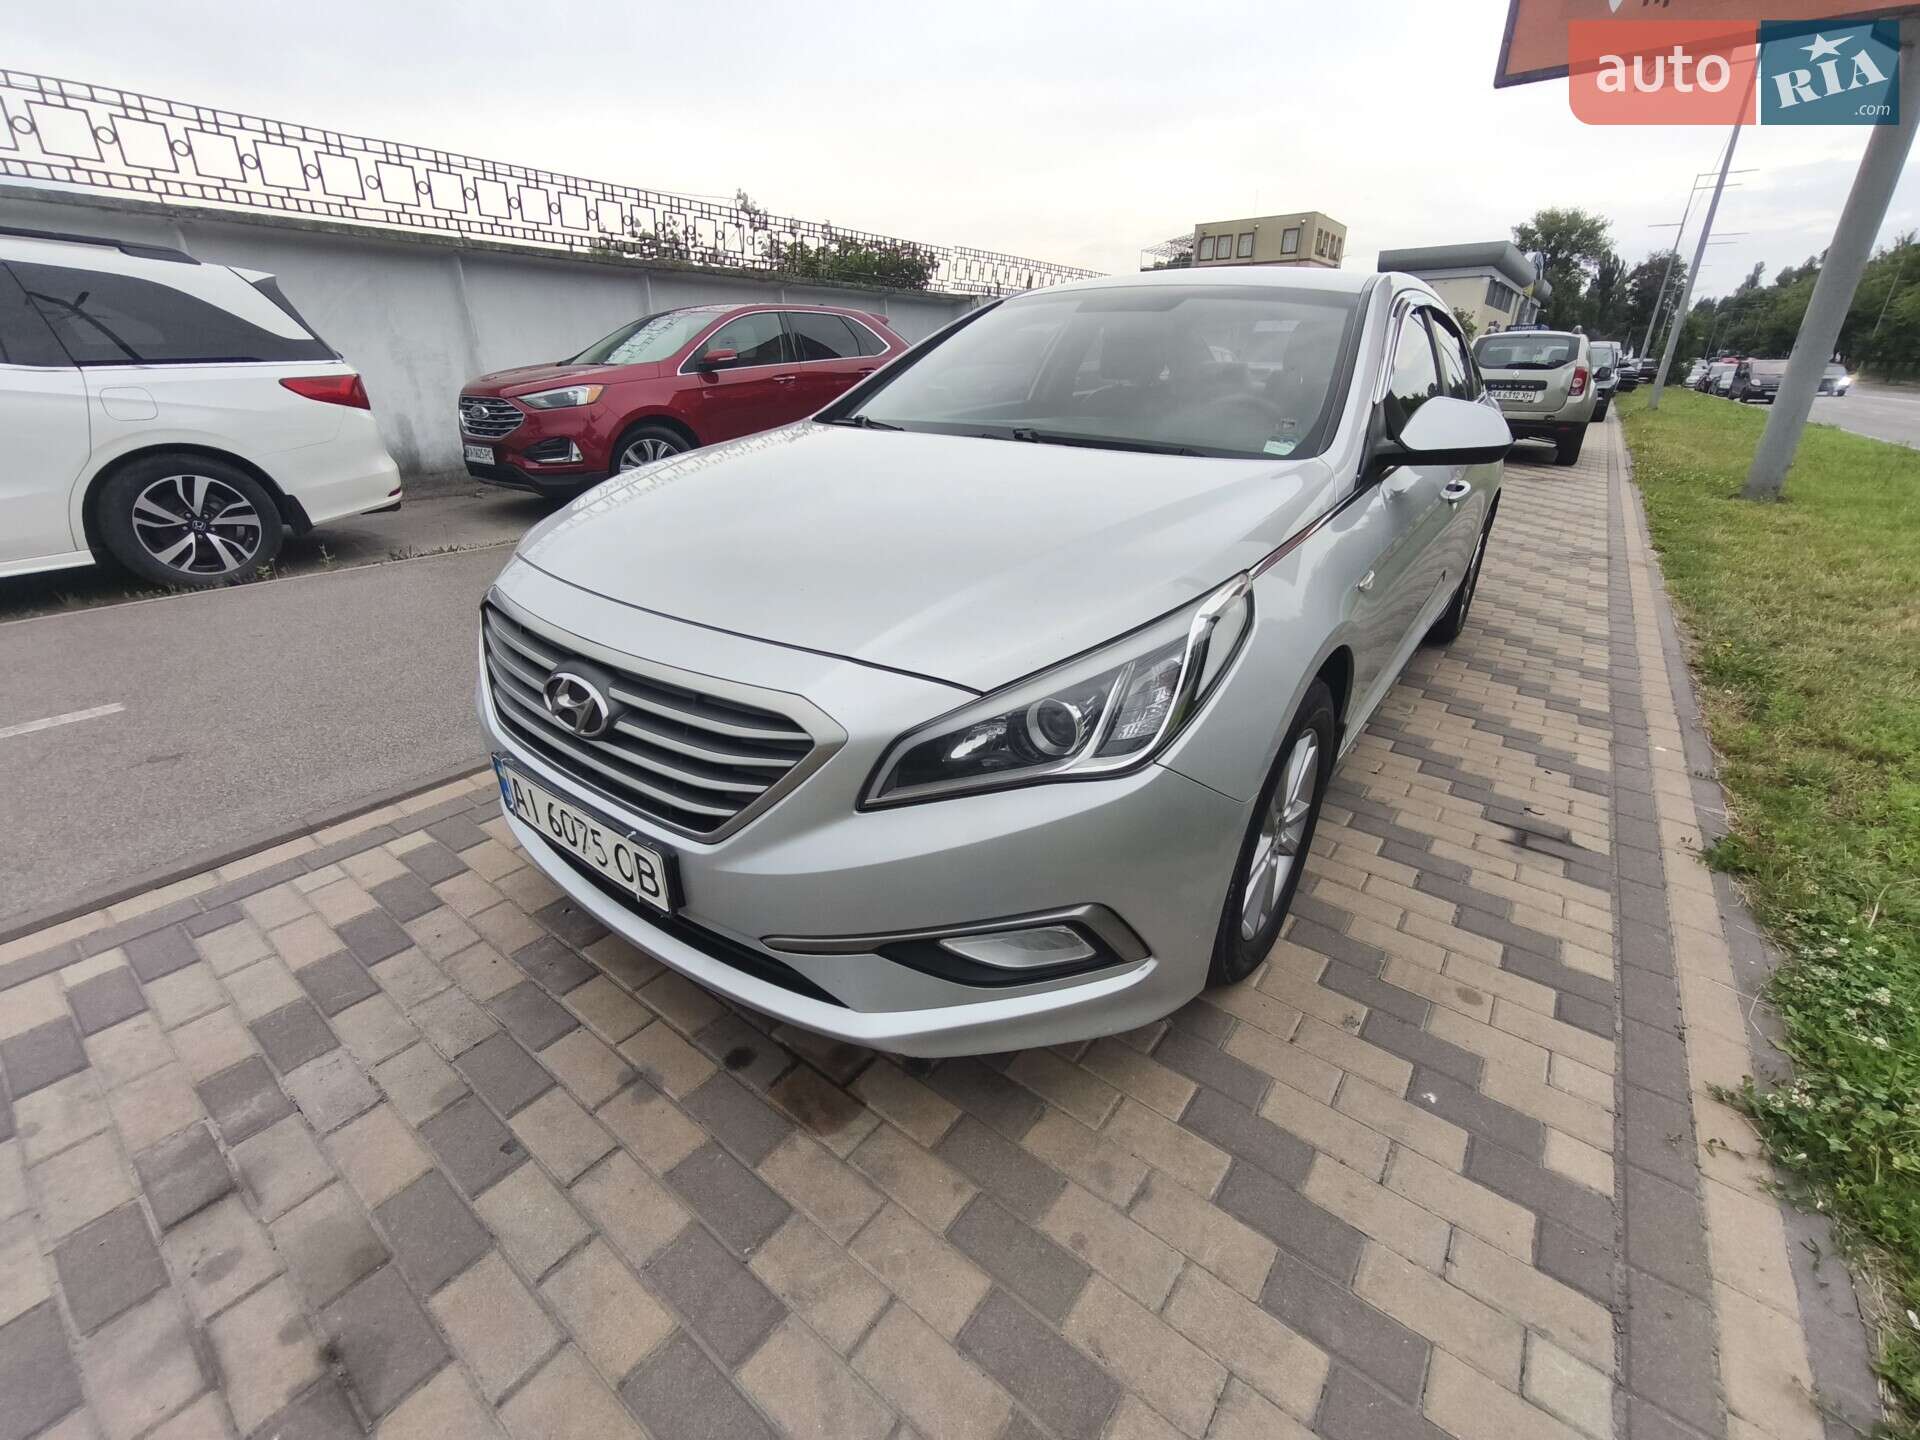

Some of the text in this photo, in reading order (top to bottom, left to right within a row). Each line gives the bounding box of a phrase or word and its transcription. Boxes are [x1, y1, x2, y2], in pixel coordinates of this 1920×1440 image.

[512, 777, 661, 898] AI 6075 OB
